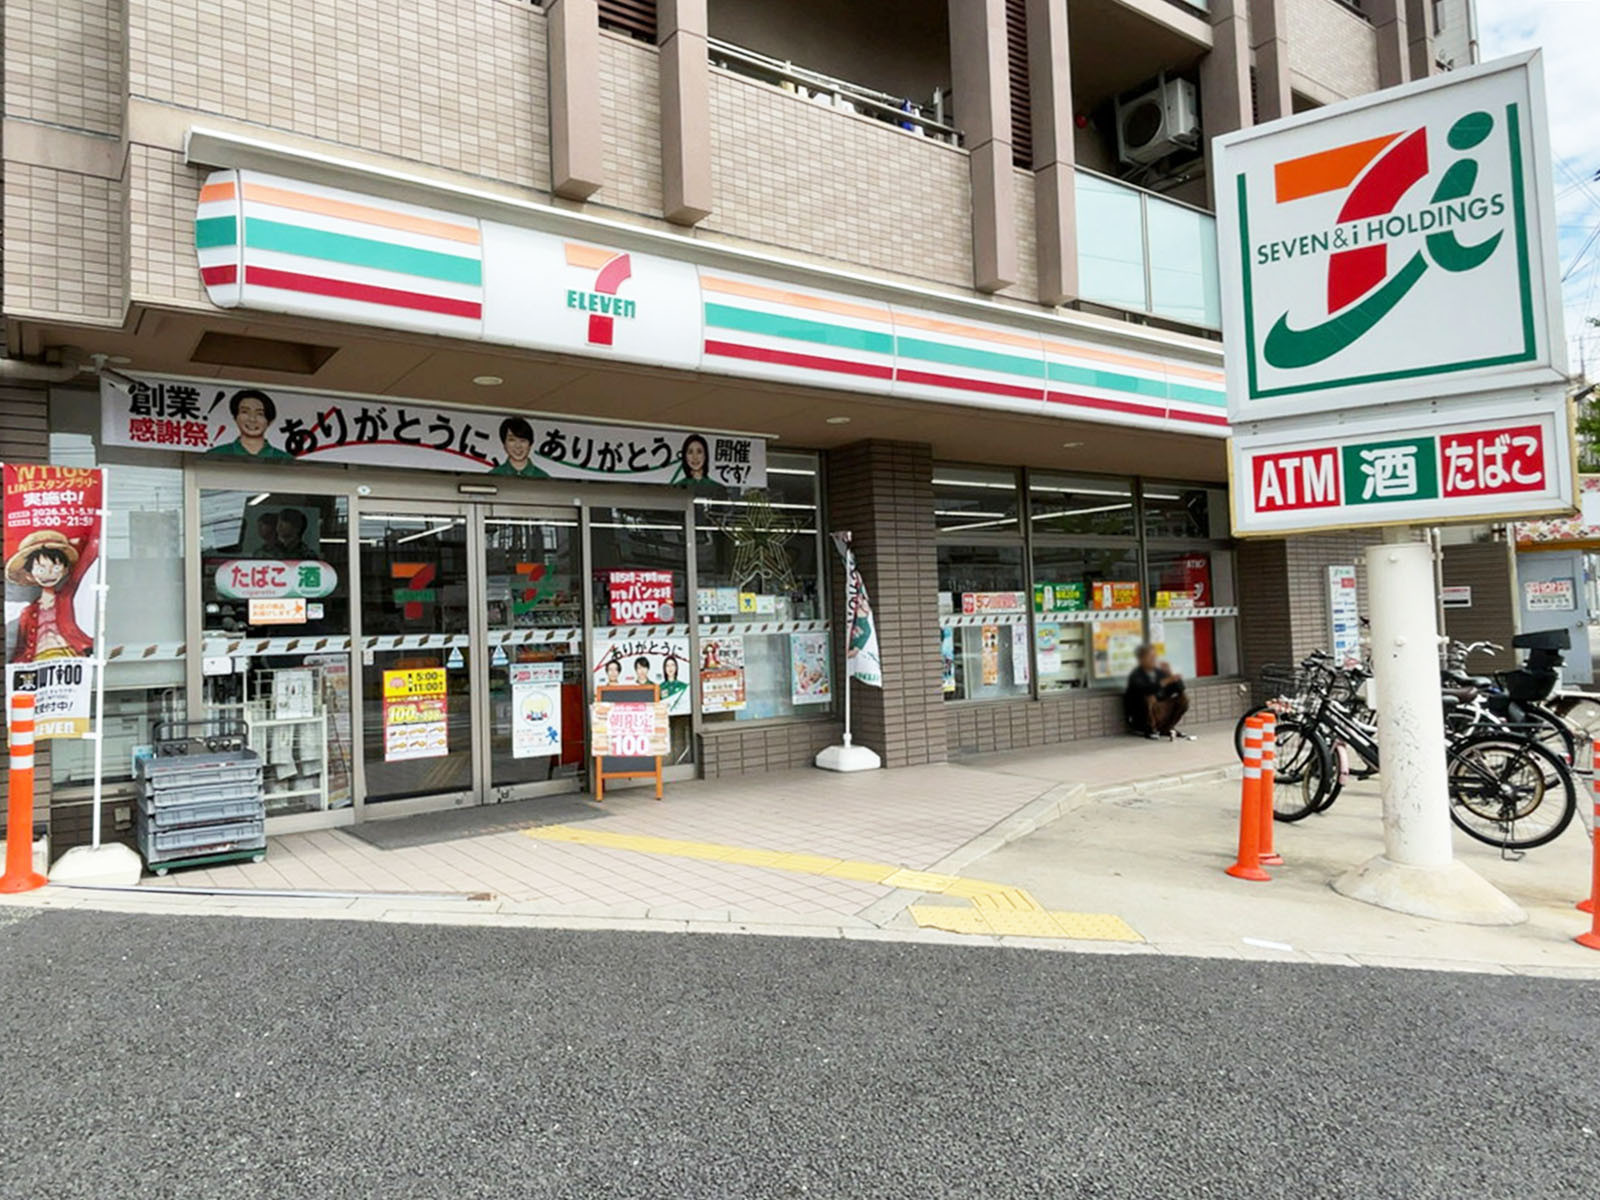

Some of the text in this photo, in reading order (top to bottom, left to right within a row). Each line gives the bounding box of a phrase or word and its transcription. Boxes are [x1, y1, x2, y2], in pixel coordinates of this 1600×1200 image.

[1367, 194, 1505, 249] HOLDINGS
[128, 417, 227, 447] 感謝祭!
[540, 429, 672, 473] ありがとう
[714, 439, 751, 463] 開催
[1445, 435, 1542, 491] たばこ
[715, 464, 751, 484] です!
[1258, 453, 1339, 507] ATM
[1360, 444, 1418, 500] 酒
[23, 489, 84, 507] 実施中!
[231, 565, 287, 588] たばこ
[298, 565, 321, 588] 酒
[611, 601, 659, 619] 100円
[612, 735, 650, 756] 100
